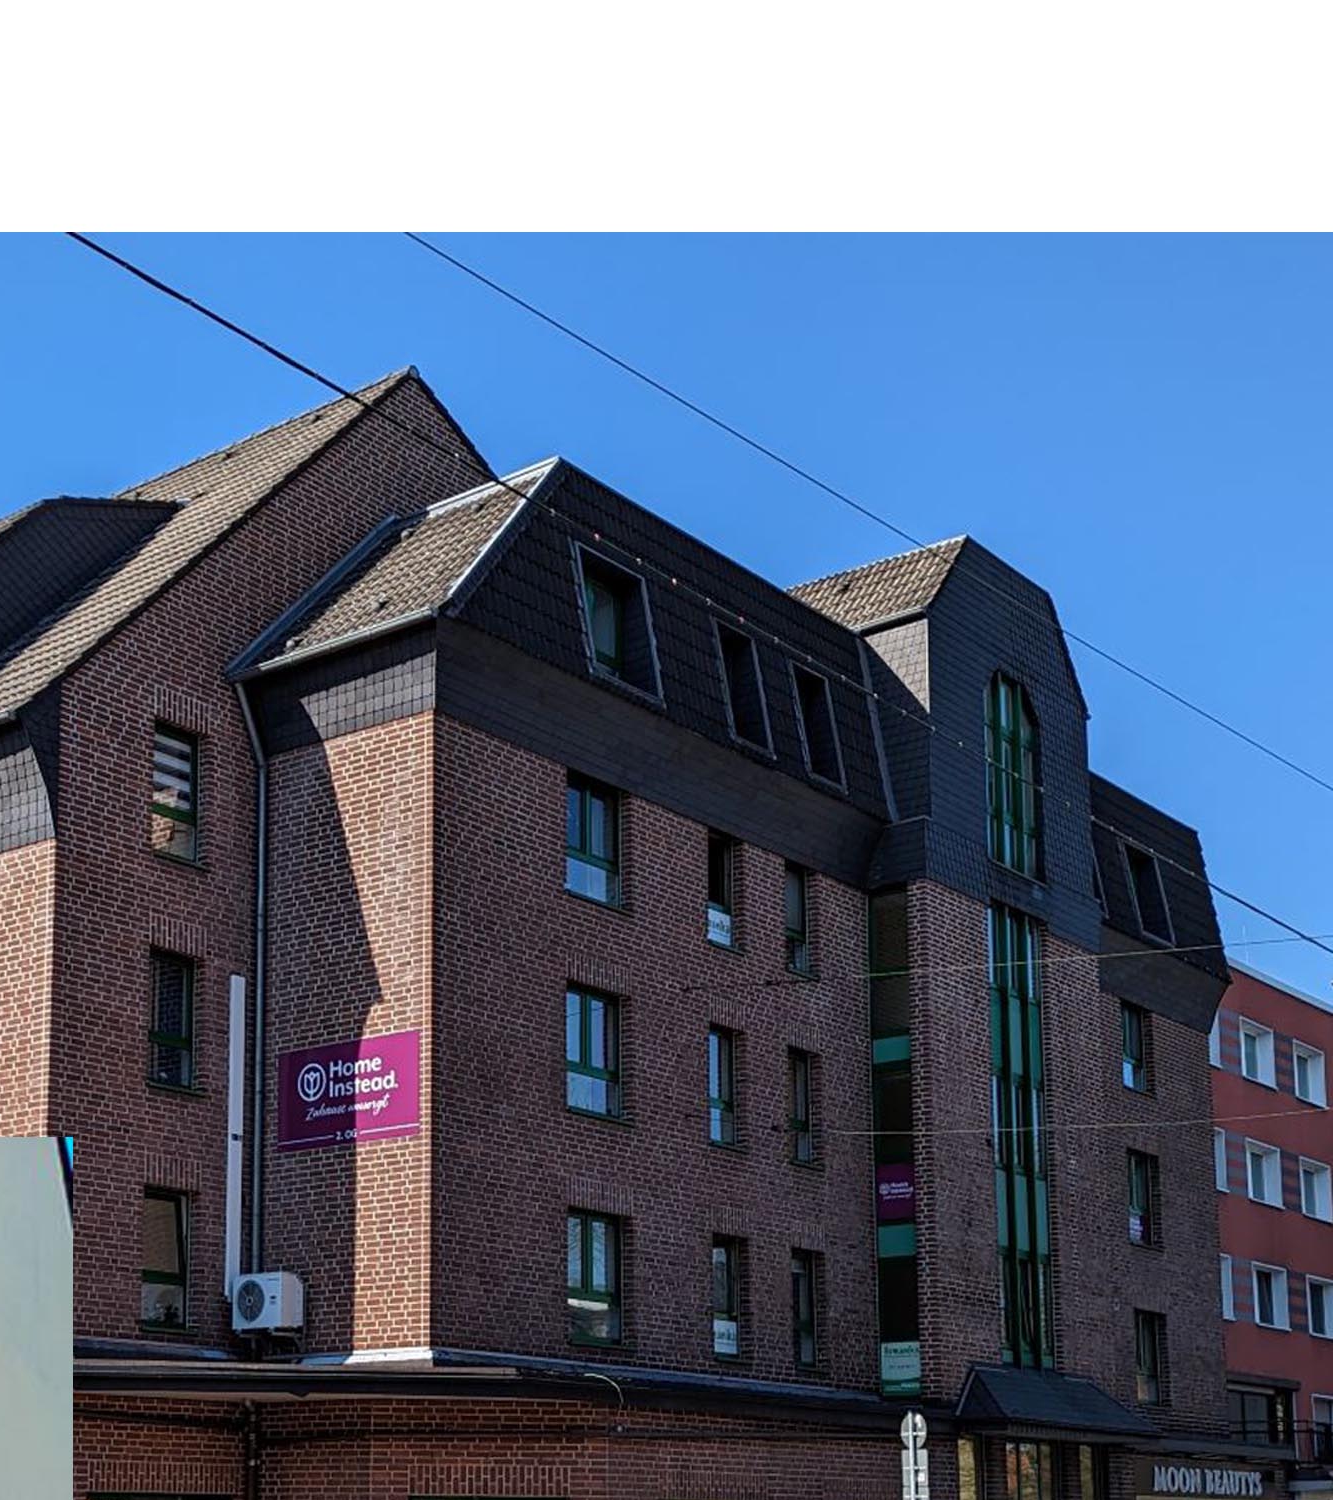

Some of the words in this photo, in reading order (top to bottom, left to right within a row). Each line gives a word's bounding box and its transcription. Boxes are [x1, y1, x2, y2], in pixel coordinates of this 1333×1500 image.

[329, 1056, 382, 1078] Home
[1153, 1465, 1202, 1494] MOON
[1204, 1470, 1263, 1497] BEAUTYS
